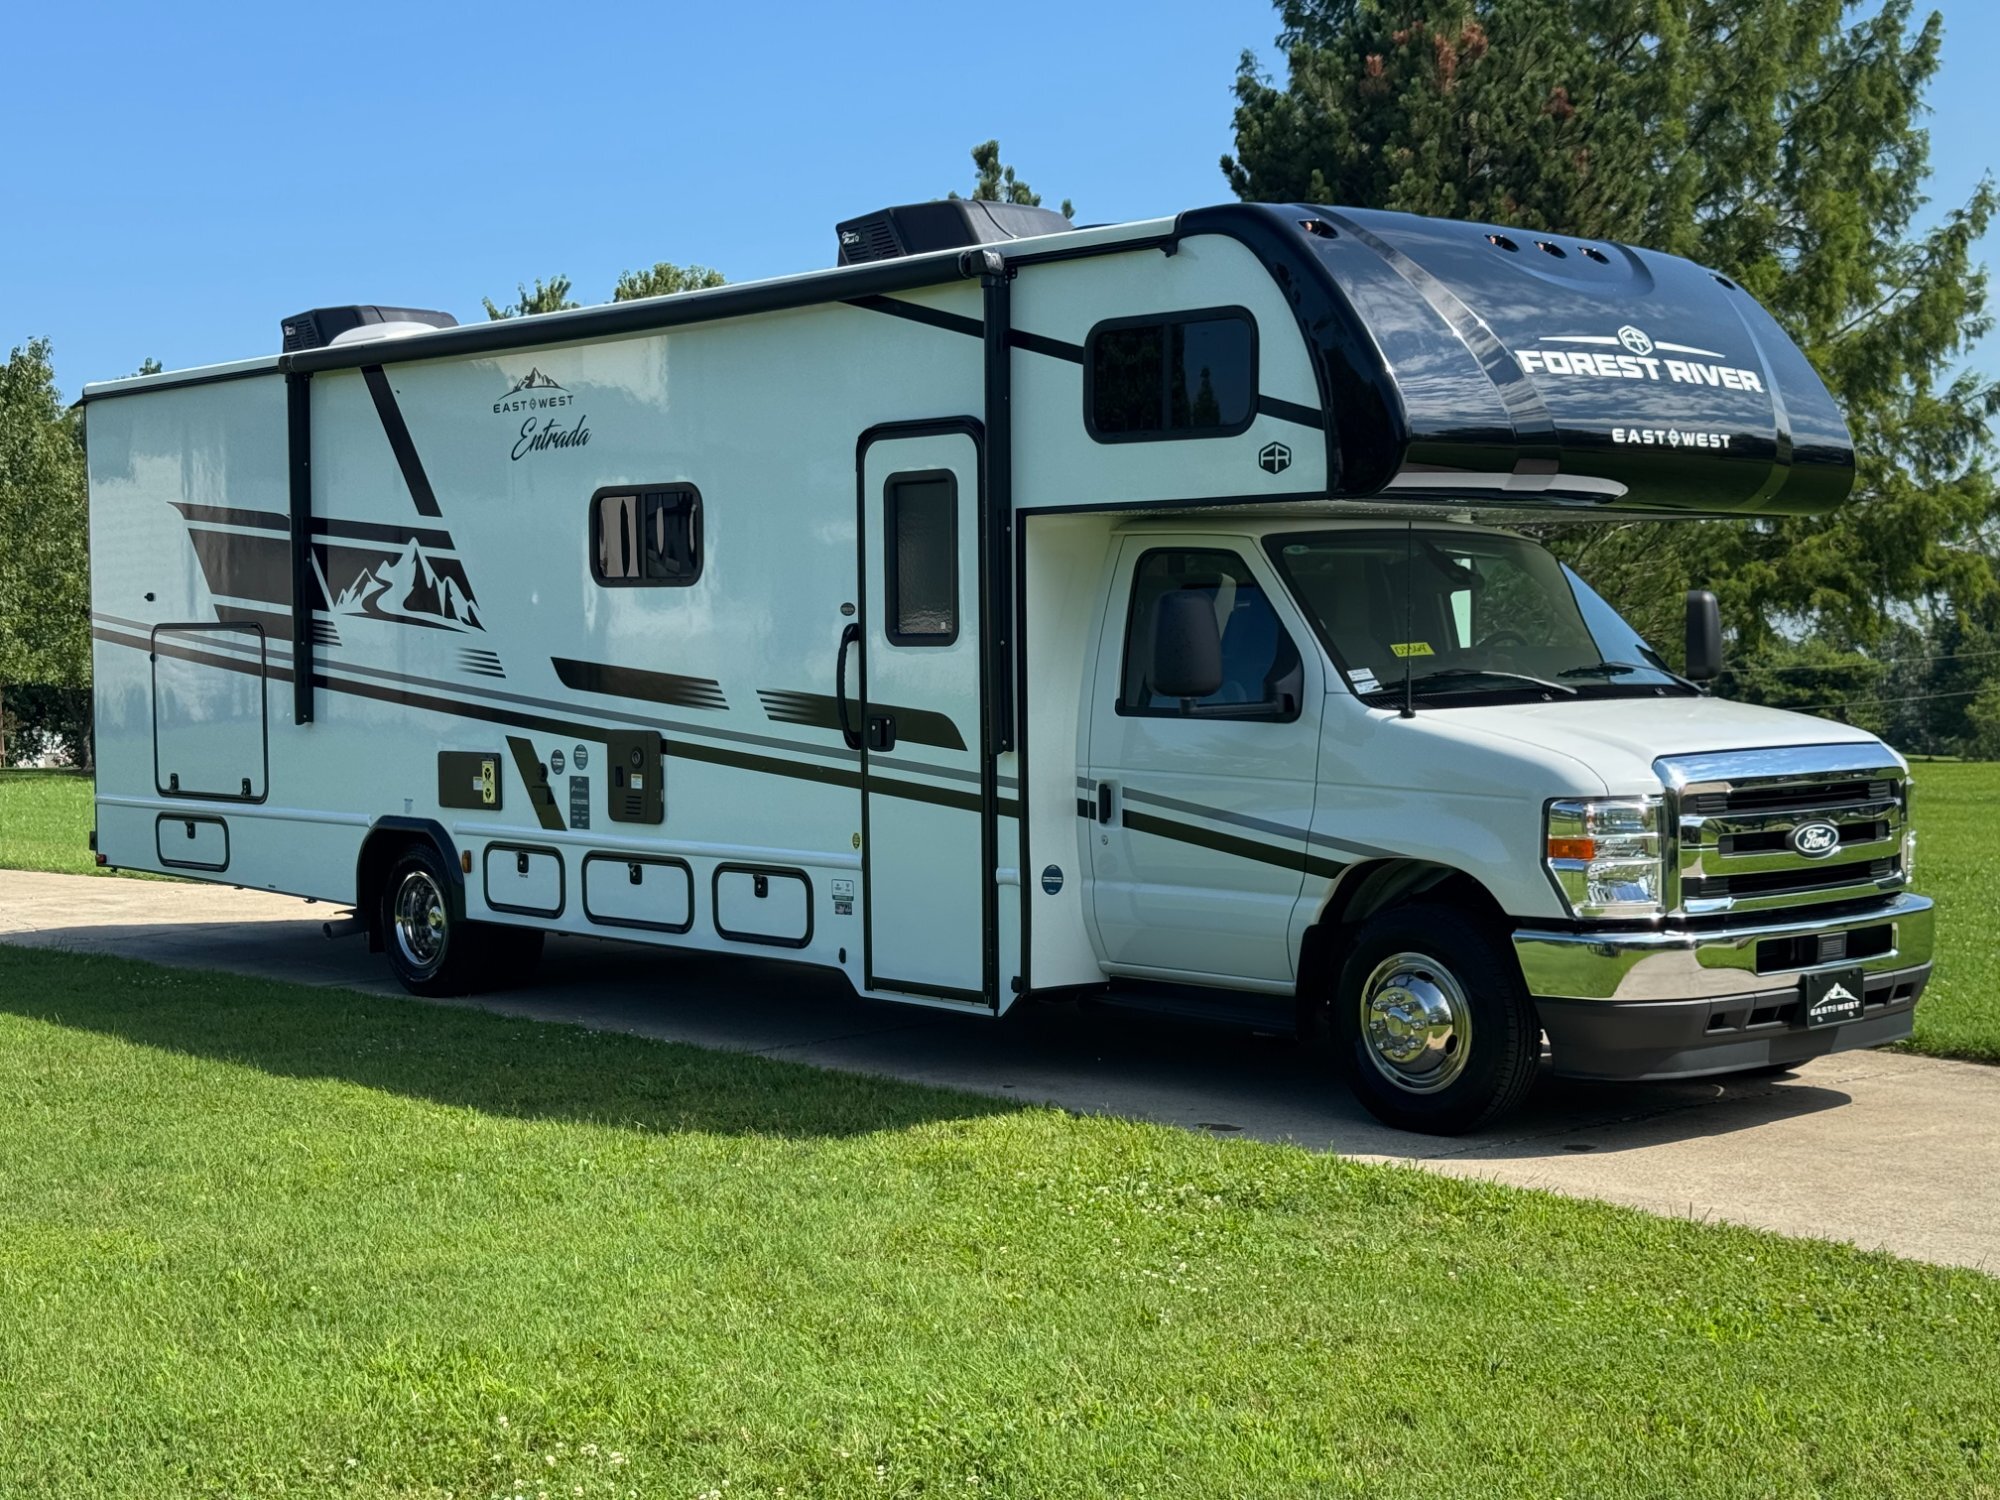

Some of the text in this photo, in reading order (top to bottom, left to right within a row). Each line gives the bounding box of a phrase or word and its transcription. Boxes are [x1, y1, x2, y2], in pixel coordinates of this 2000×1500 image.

[1514, 350, 1765, 393] FOREST RIVER
[493, 395, 574, 413] EAST WEST
[511, 414, 592, 461] Entrada
[1611, 428, 1731, 449] EAST WEST
[1803, 828, 1832, 849] Ford
[1810, 1000, 1861, 1016] EAST WEST
